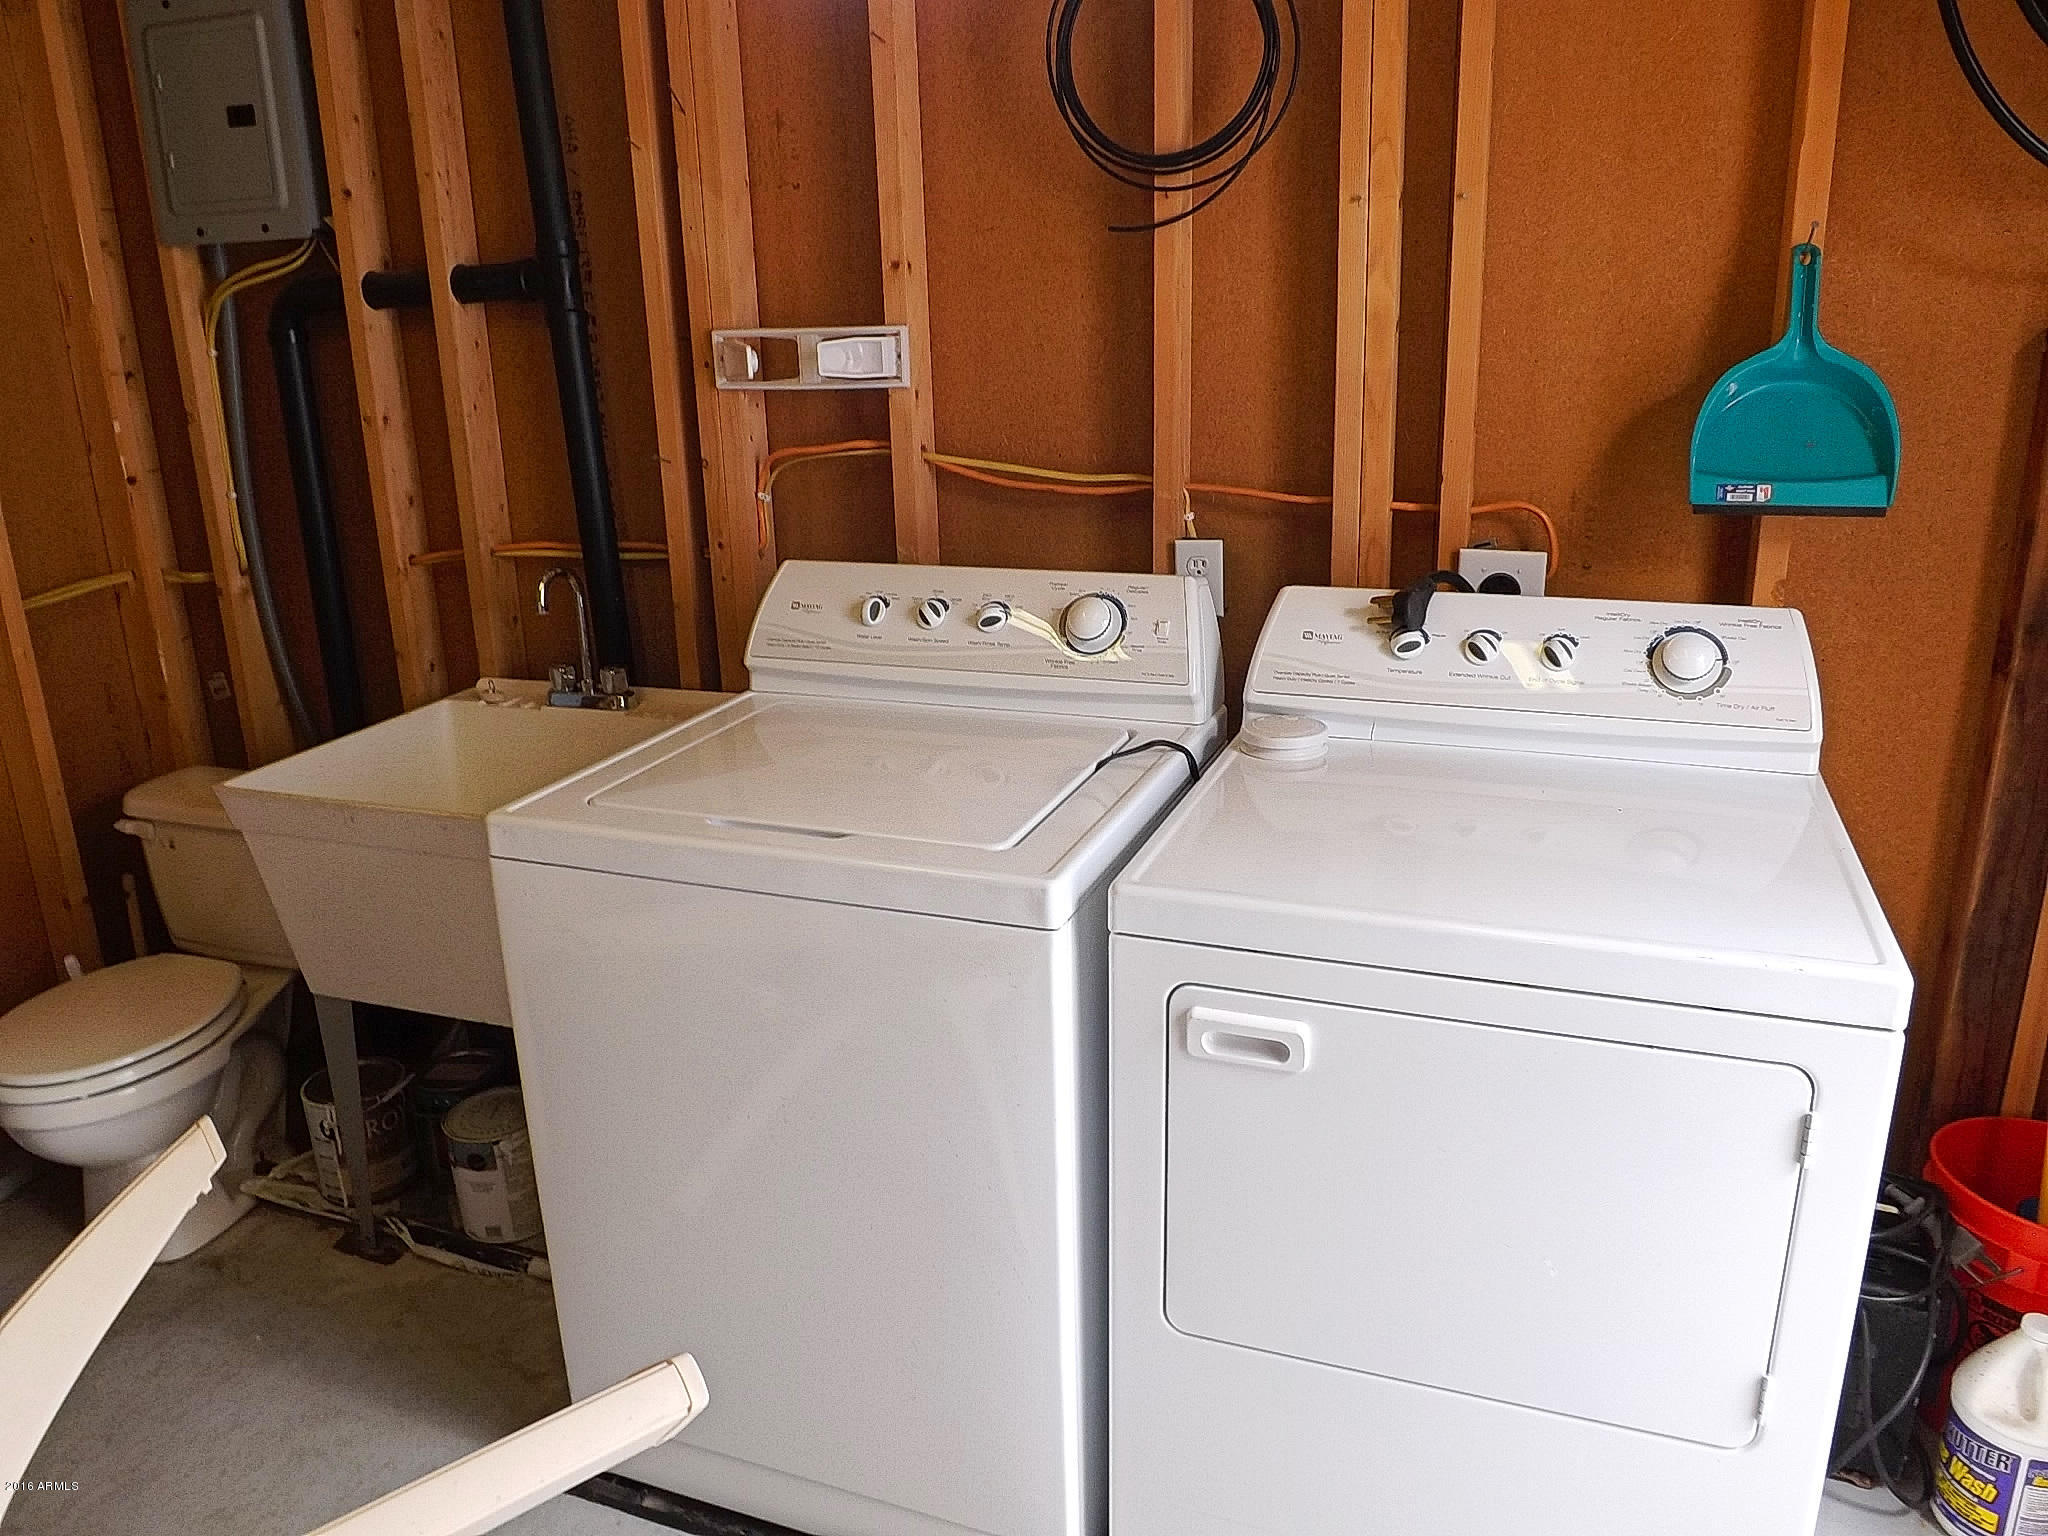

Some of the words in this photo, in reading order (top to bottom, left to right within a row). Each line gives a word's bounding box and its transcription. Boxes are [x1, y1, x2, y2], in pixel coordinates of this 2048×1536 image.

[1314, 632, 1343, 641] MAYTAG
[1386, 667, 1423, 675] Temperature
[1448, 671, 1477, 679] Extended
[1733, 703, 1747, 711] Dry
[1761, 704, 1776, 712] Fluff
[1949, 1454, 1999, 1504] Wash
